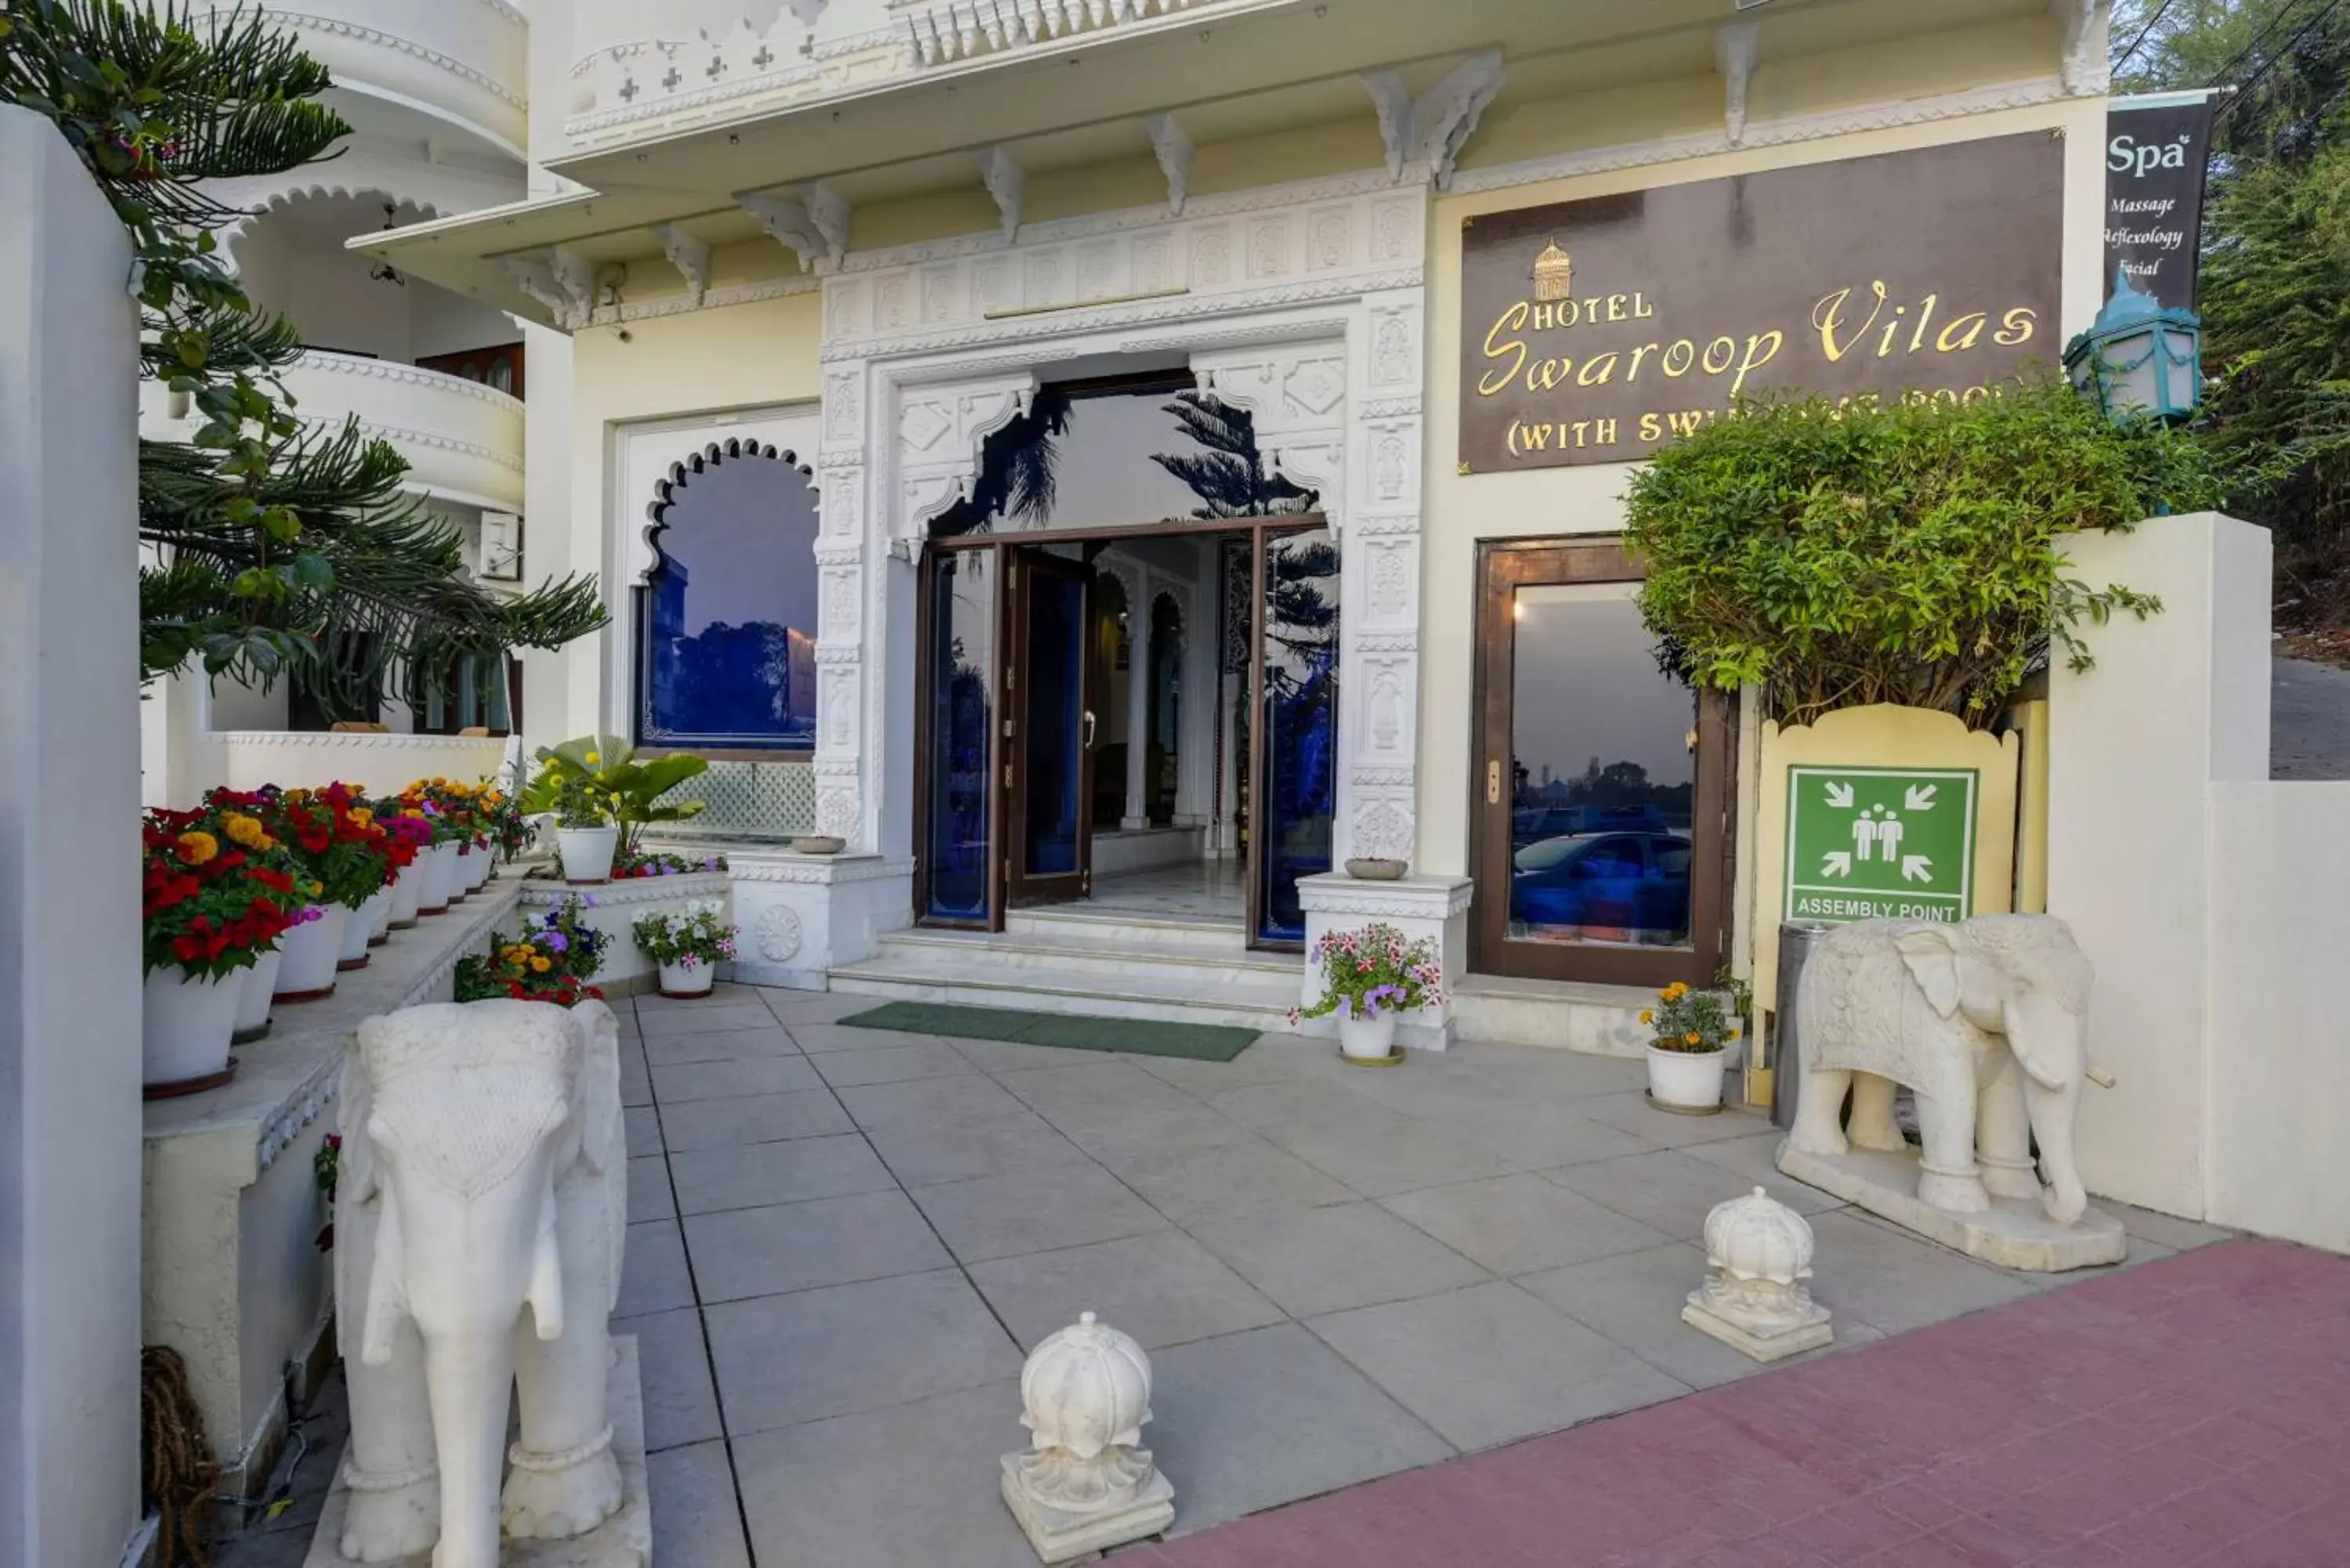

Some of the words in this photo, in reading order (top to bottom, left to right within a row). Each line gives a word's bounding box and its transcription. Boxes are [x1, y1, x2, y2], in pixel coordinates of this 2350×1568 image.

[2106, 135, 2185, 178] Spa
[2111, 197, 2176, 219] Massage
[1533, 292, 1654, 331] HOTEL
[1478, 301, 1784, 398] Swaroop
[1812, 280, 2038, 364] Vilas
[1507, 417, 1617, 456] (WITH
[1798, 898, 1893, 918] ASSEMBLY
[1900, 903, 1956, 922] POINT
